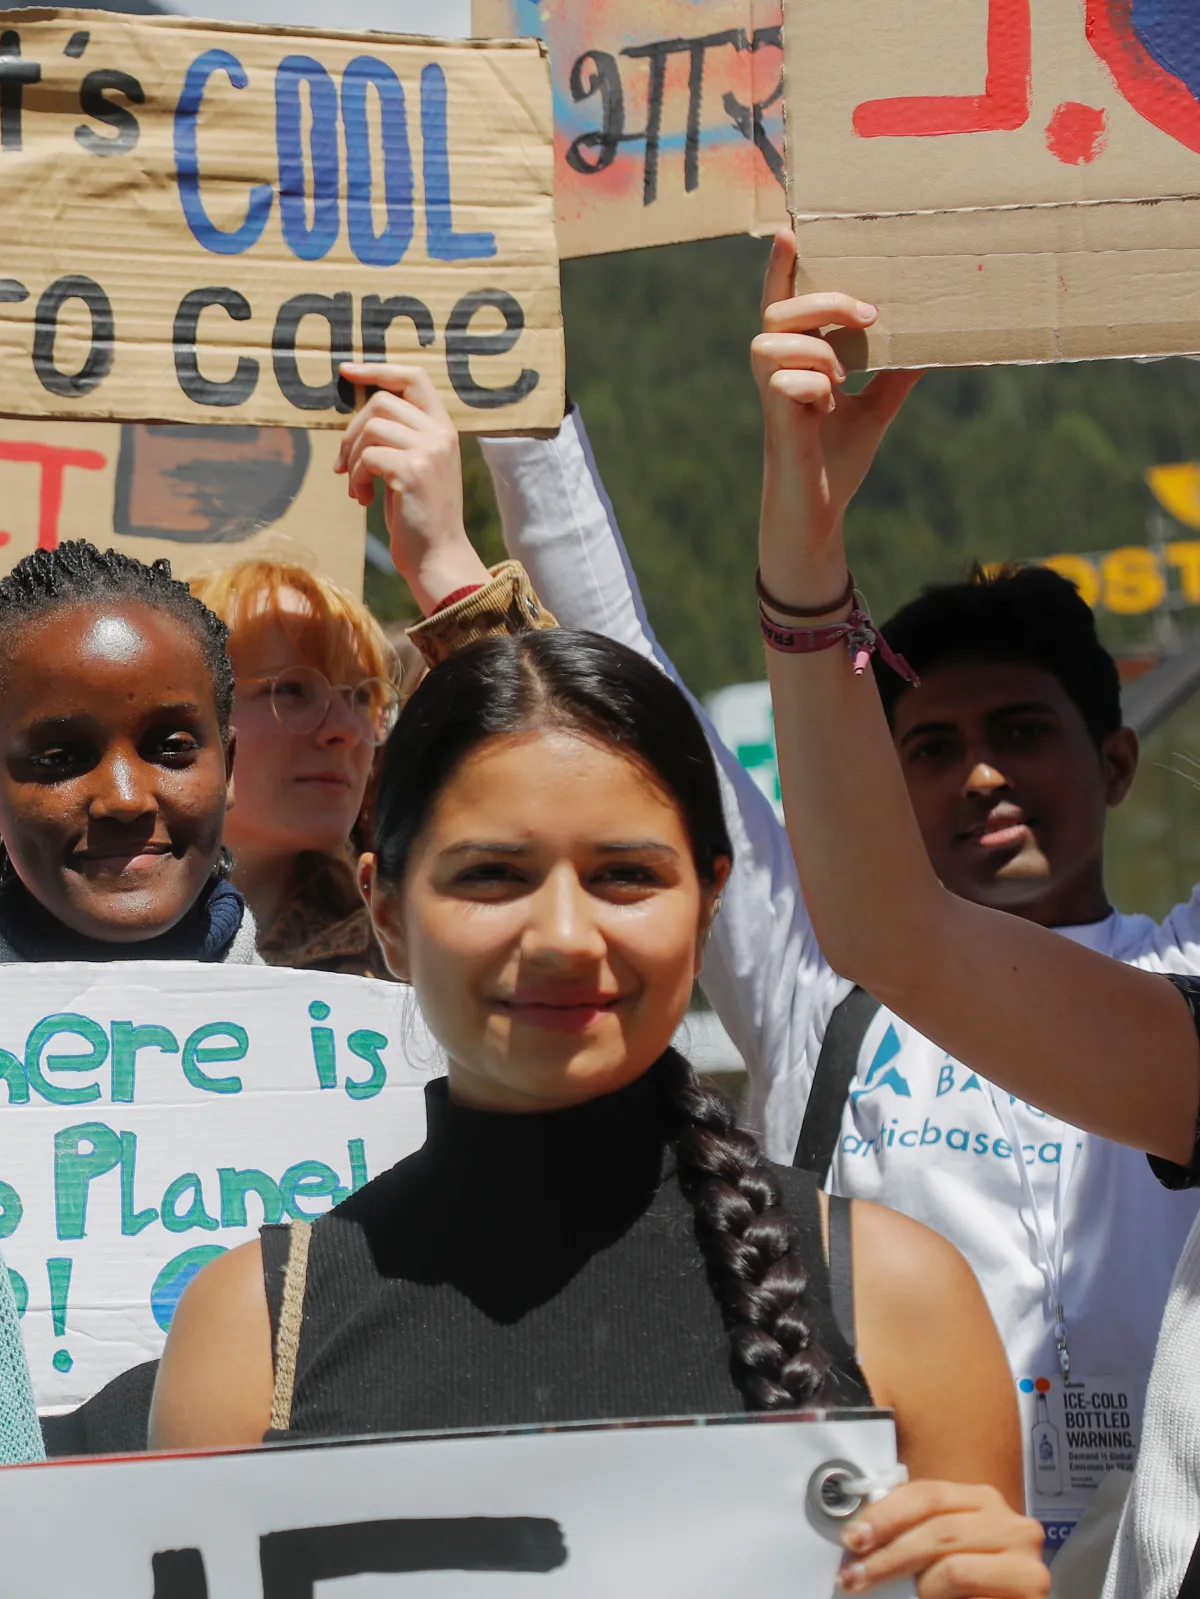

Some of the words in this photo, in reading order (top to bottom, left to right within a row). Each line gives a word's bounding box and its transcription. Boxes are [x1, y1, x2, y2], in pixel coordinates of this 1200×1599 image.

[173, 48, 498, 267] COOL
[172, 286, 539, 414] care
[308, 1000, 388, 1100] is
[1063, 1392, 1128, 1409] ICE-COLD
[1065, 1412, 1131, 1429] BOTTLED
[1066, 1431, 1136, 1448] WARNING.
